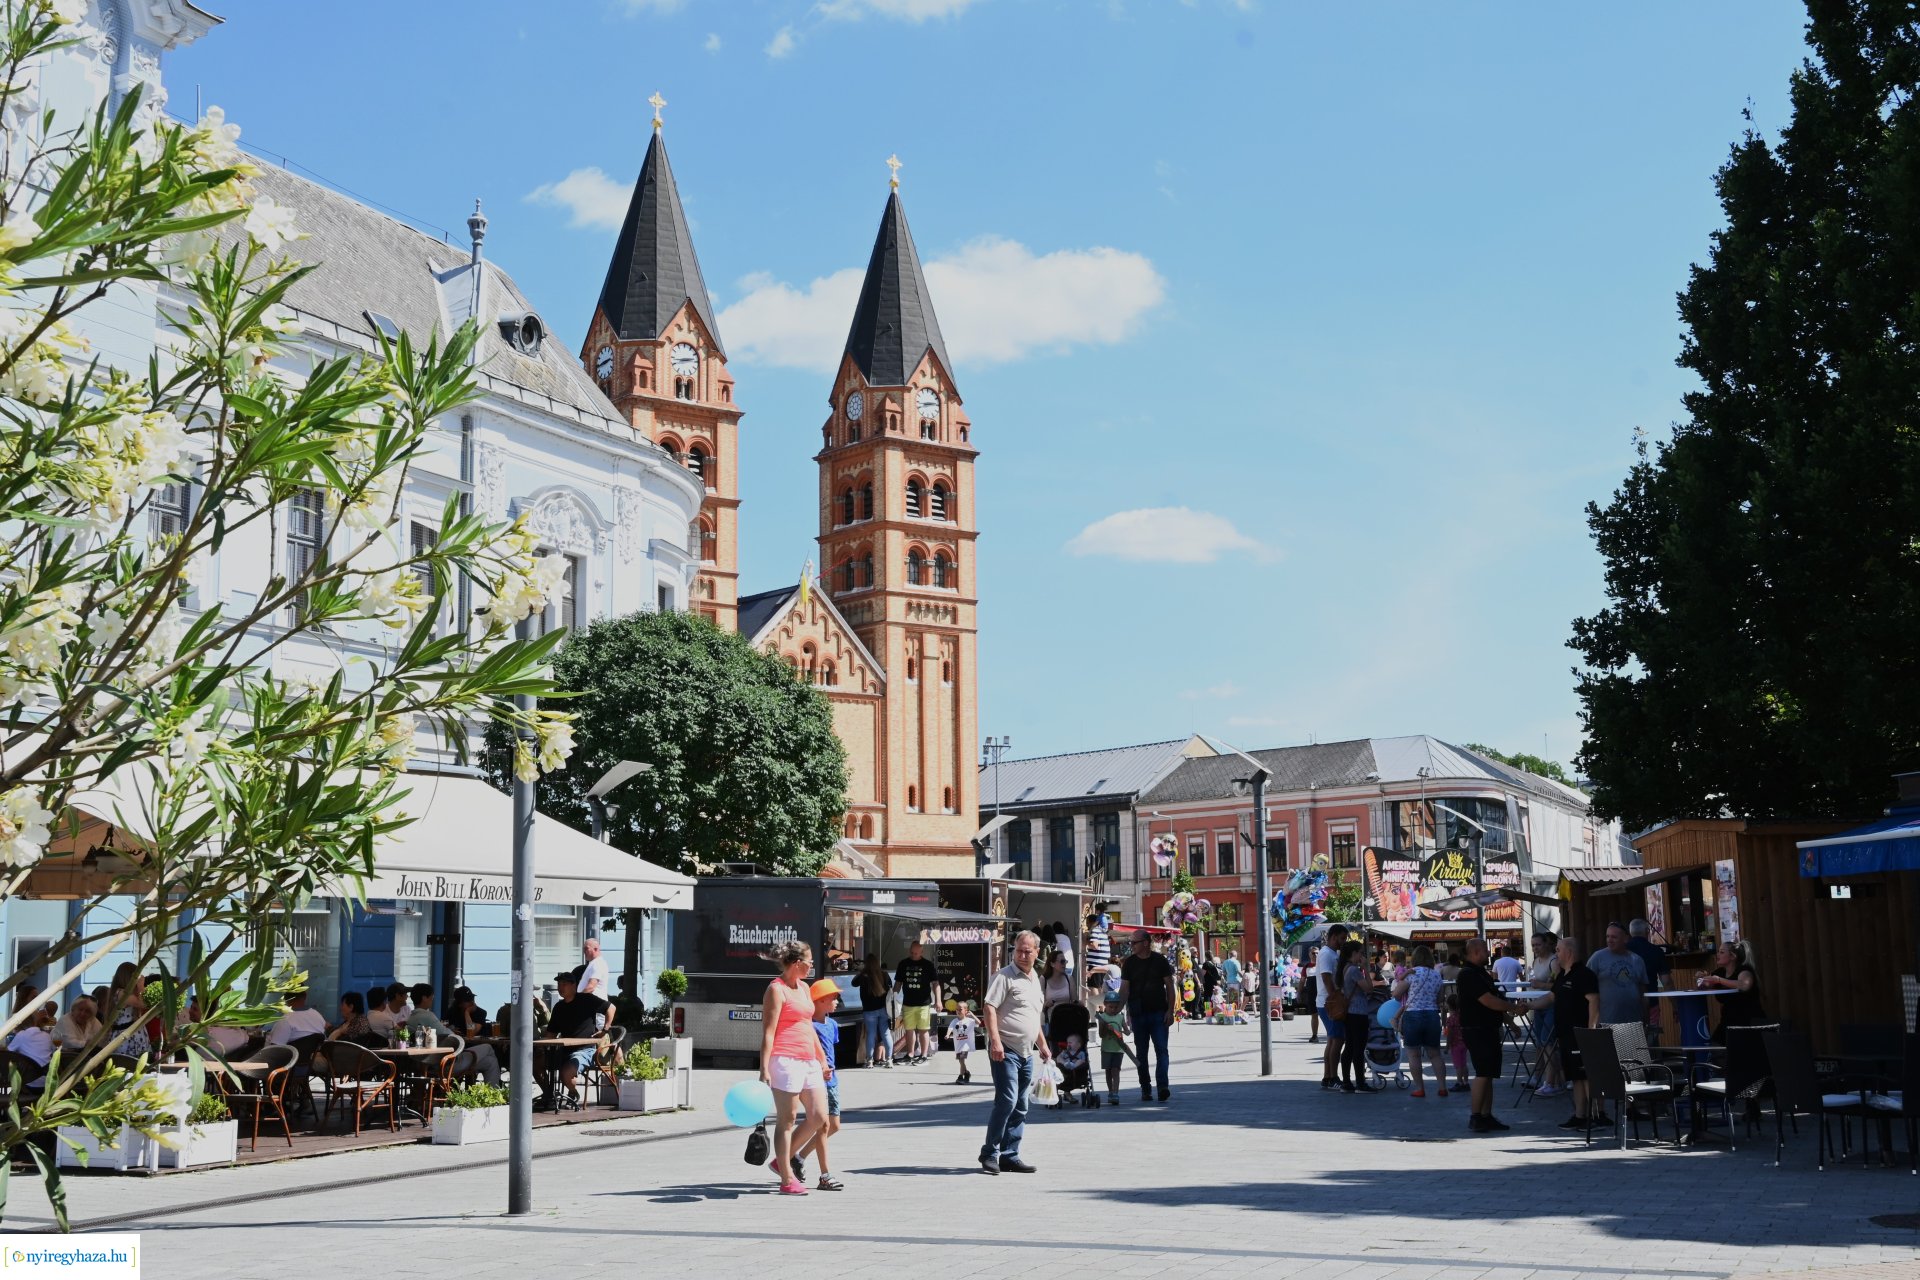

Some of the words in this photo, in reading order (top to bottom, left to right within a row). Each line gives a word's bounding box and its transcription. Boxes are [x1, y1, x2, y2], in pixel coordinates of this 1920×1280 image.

[1382, 860, 1420, 871] AMERIKAI
[397, 874, 432, 897] JOHN
[435, 876, 466, 899] BULL
[469, 878, 513, 901] KORON
[942, 926, 979, 942] CHURROS
